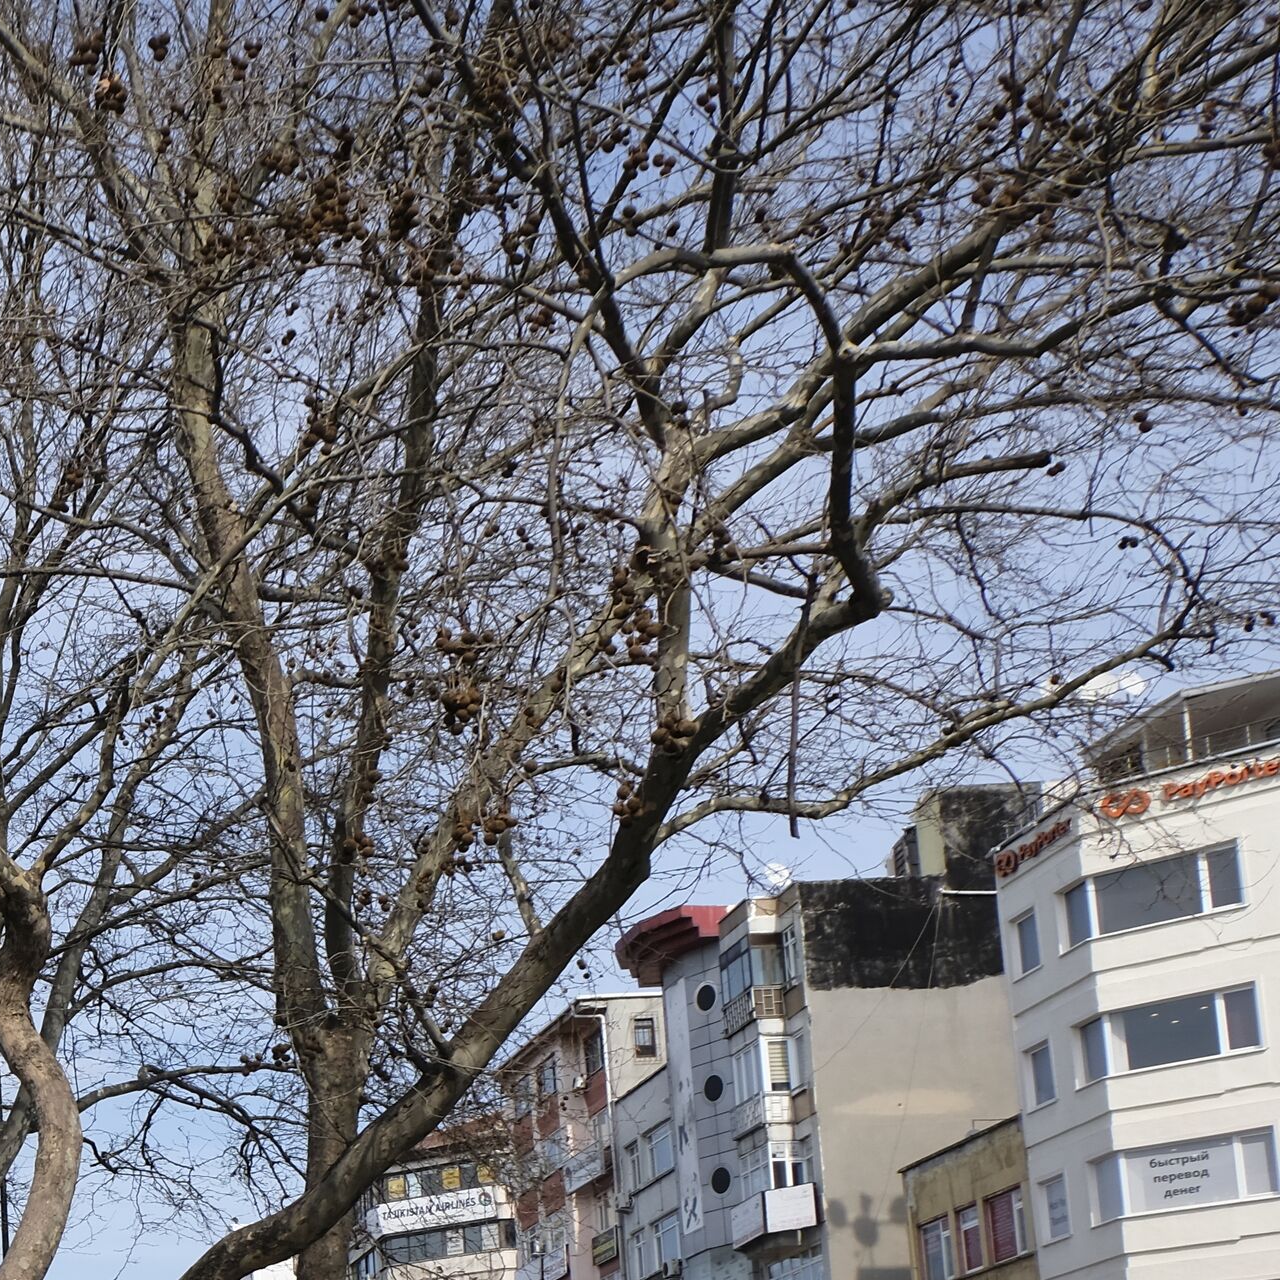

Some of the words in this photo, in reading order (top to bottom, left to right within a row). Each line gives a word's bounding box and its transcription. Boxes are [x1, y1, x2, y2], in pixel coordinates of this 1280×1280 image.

[1149, 1150, 1210, 1169] быстрый
[1153, 1167, 1211, 1185] перевод
[1163, 1184, 1202, 1199] денег
